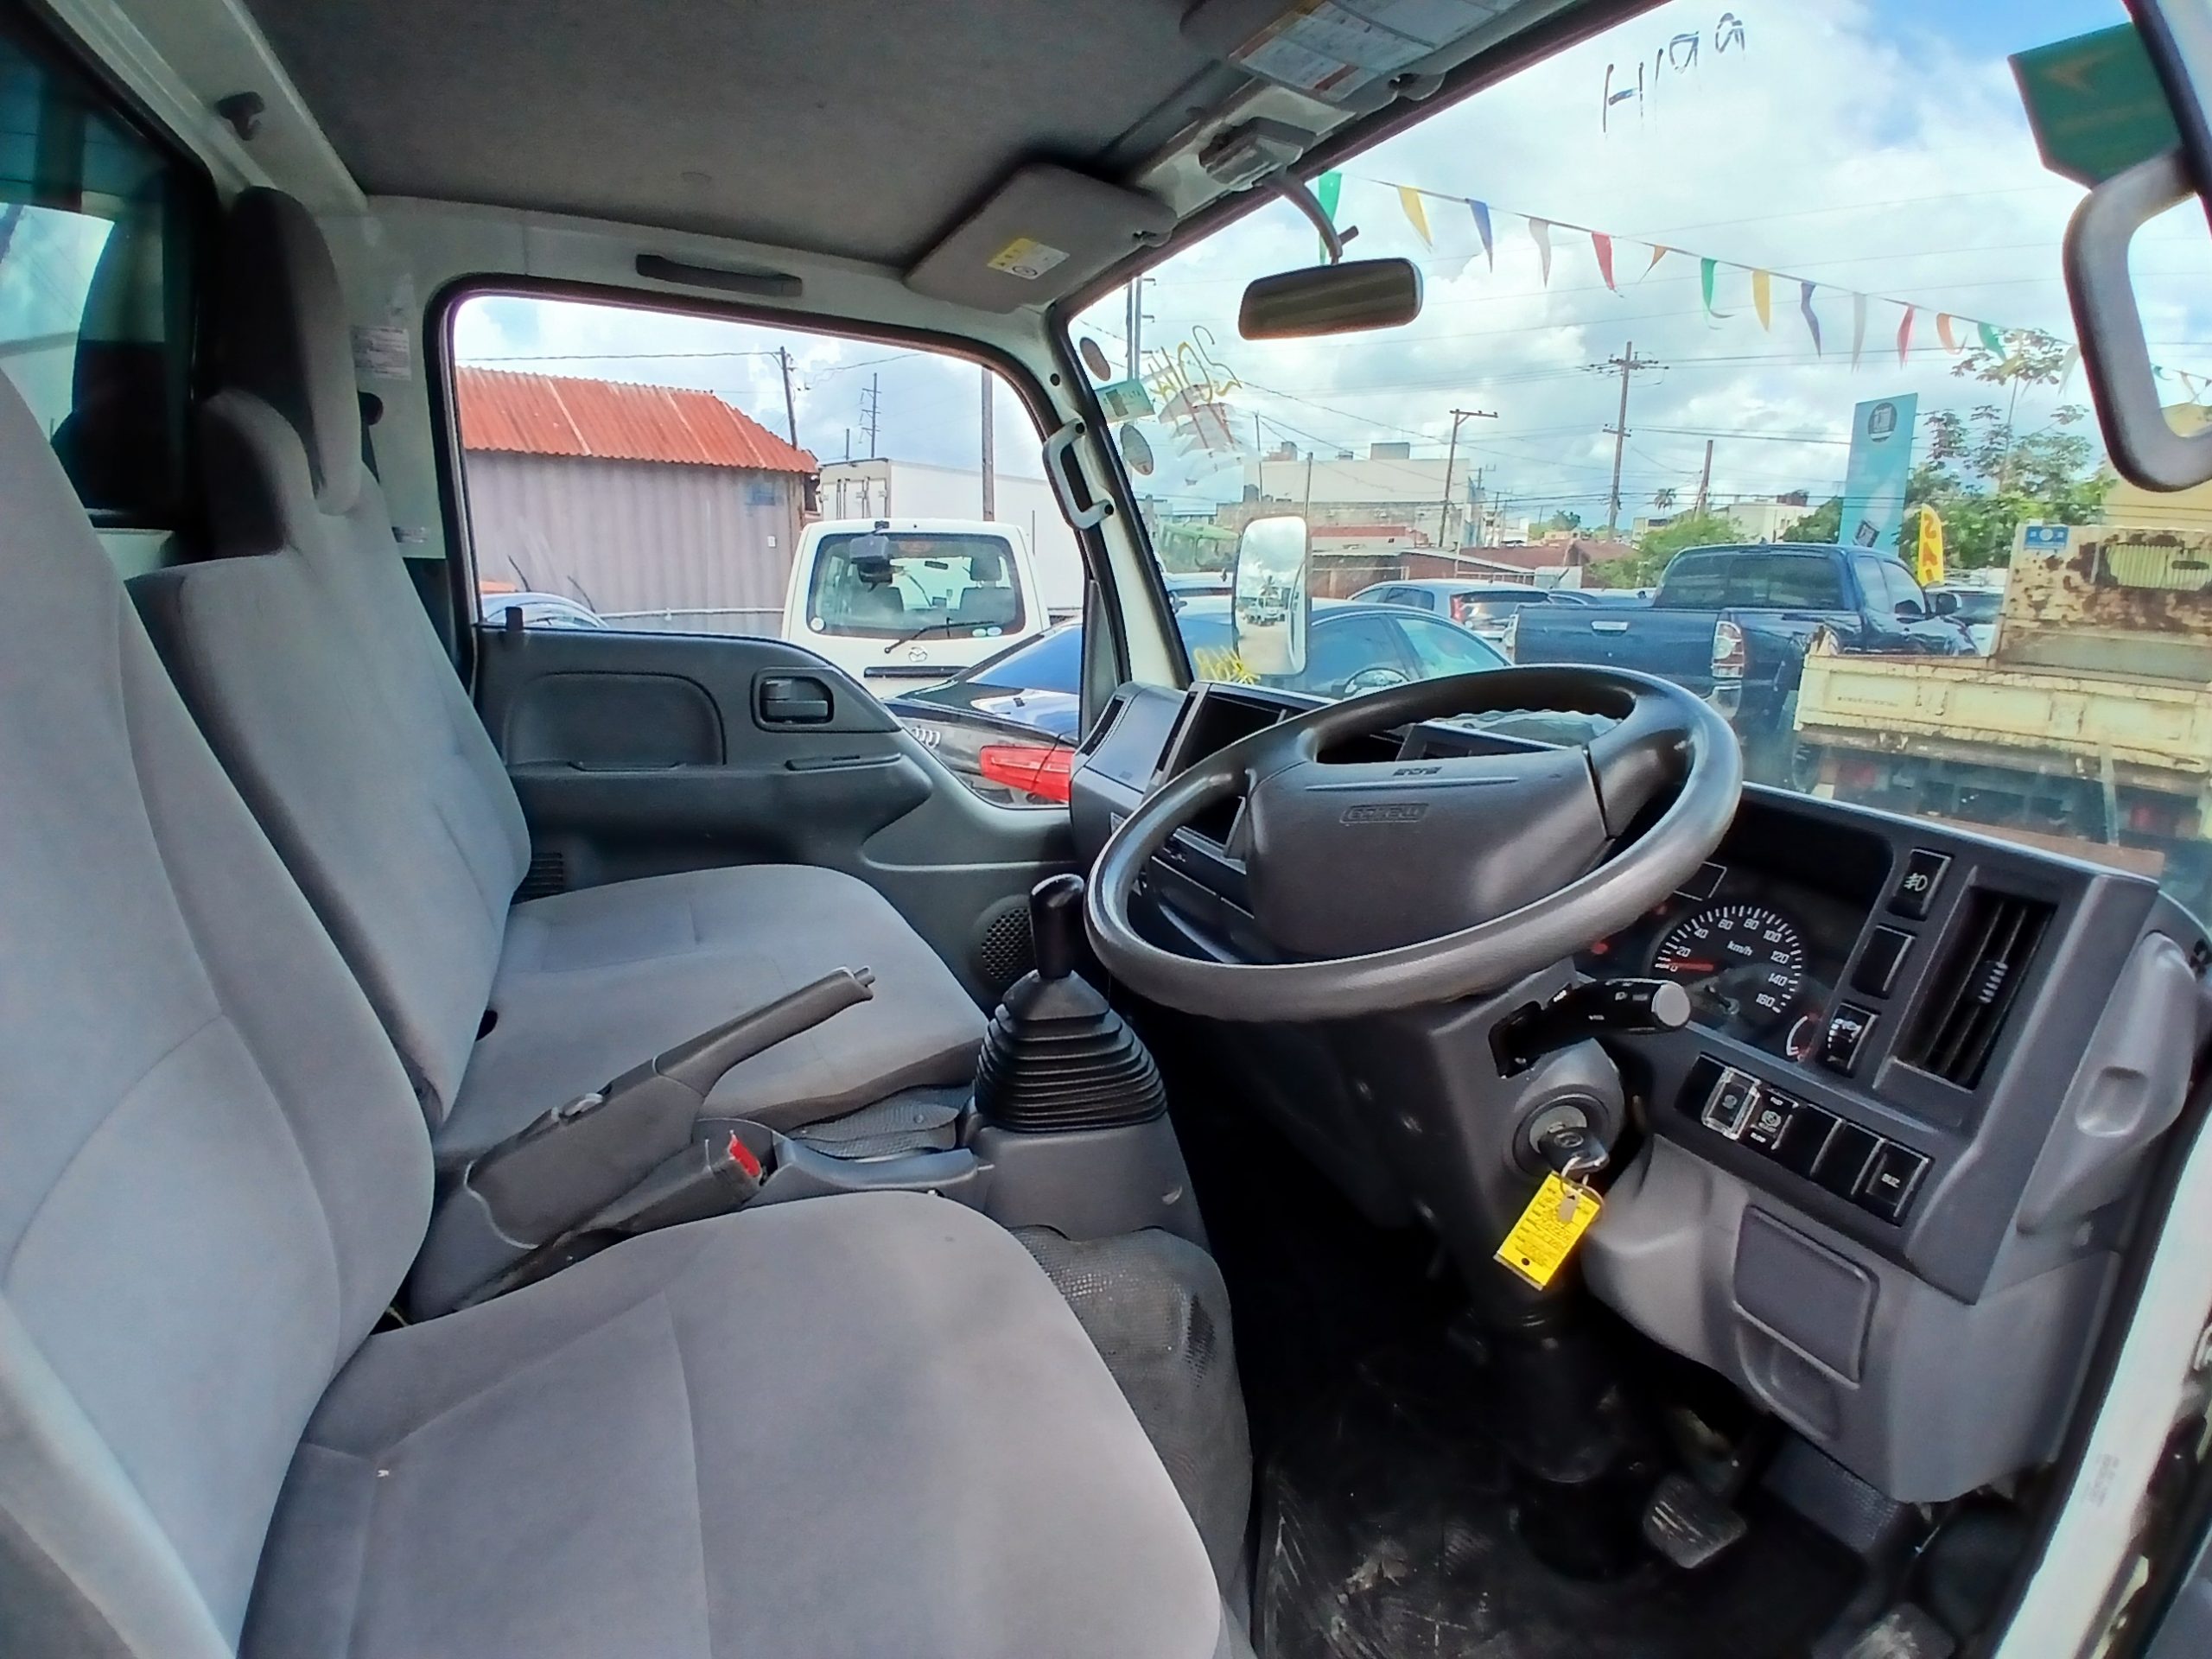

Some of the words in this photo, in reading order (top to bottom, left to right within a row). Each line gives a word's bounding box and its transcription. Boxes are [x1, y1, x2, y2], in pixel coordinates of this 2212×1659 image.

[1718, 919, 1733, 931] 60
[1744, 918, 1760, 931] 80
[1694, 929, 1709, 939] 40
[1763, 931, 1783, 944] 100
[1676, 945, 1691, 958] 20
[1727, 940, 1753, 957] km/h
[1770, 950, 1789, 964] 120
[1768, 973, 1788, 987] 140
[1756, 994, 1776, 1007] 160
